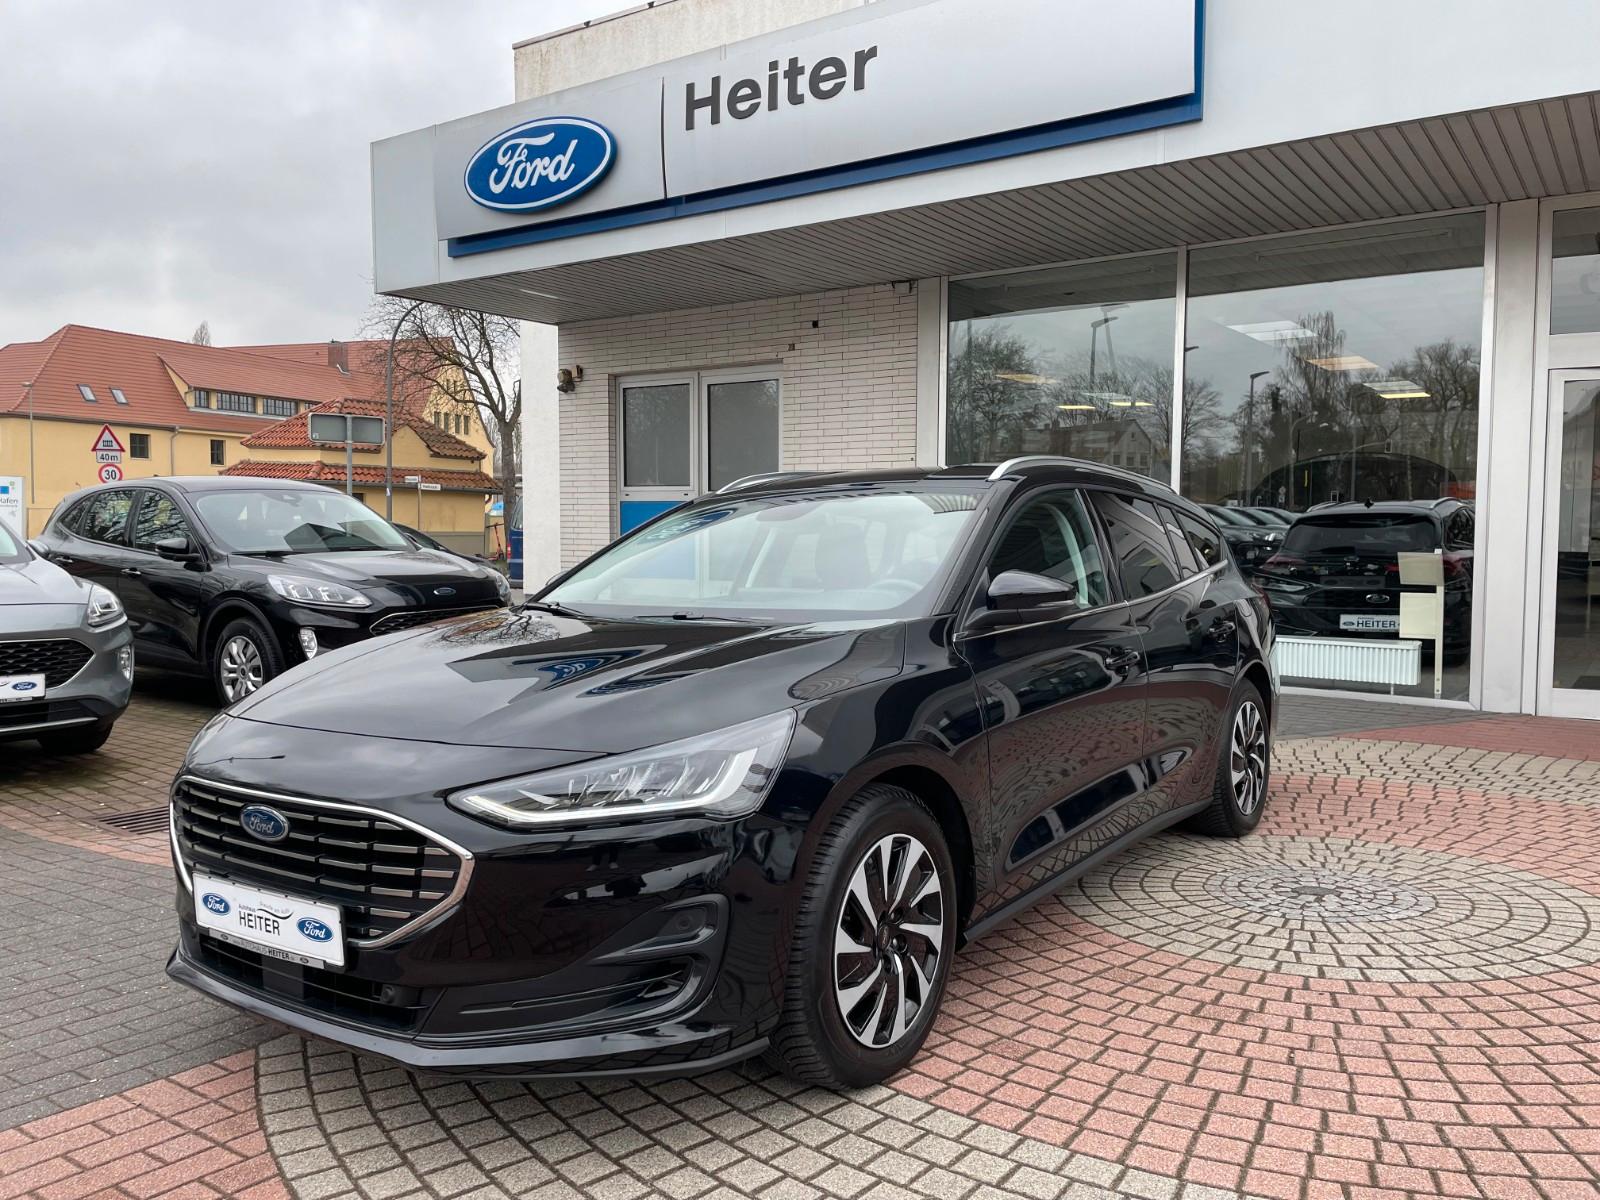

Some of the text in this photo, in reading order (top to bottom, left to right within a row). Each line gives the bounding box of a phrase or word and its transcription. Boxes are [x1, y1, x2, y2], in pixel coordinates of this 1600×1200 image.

[685, 45, 878, 131] Heiter
[489, 132, 578, 194] Ford
[104, 469, 117, 480] 30
[1356, 620, 1396, 629] HEITER
[249, 812, 275, 834] Ford
[239, 911, 280, 935] HEITER
[303, 921, 326, 939] Ford
